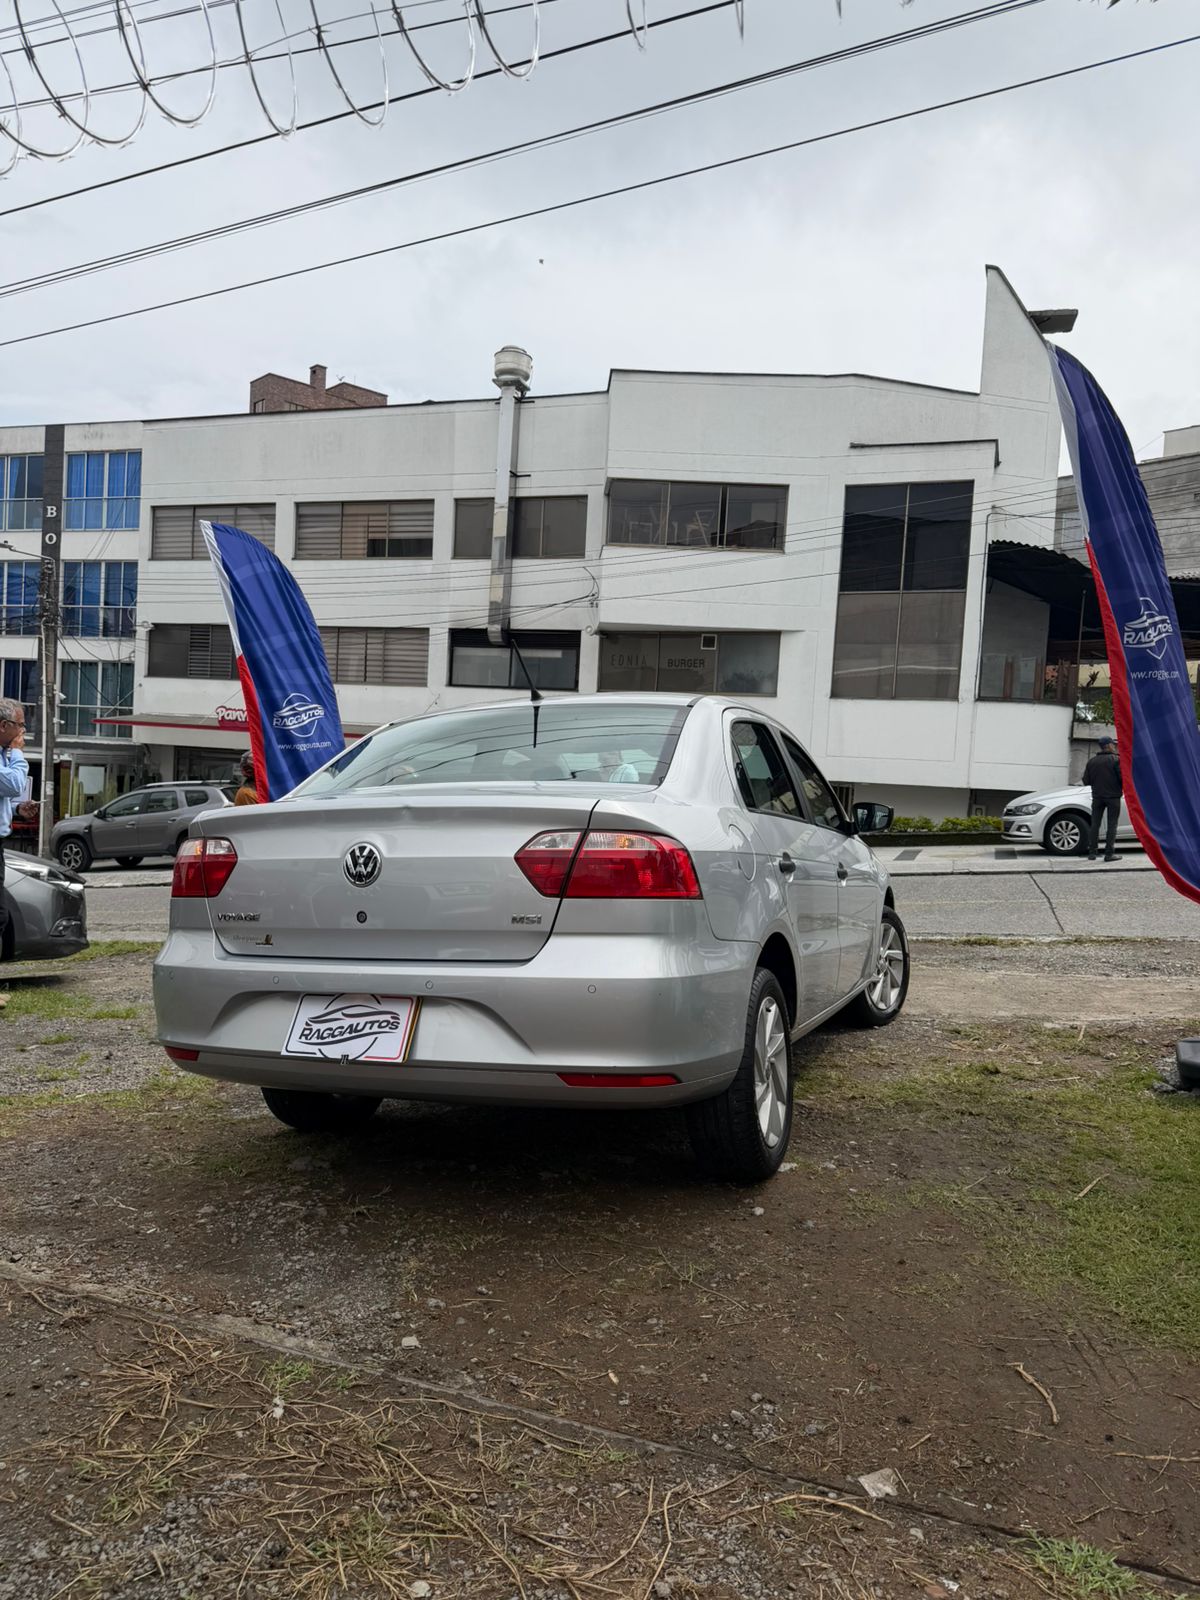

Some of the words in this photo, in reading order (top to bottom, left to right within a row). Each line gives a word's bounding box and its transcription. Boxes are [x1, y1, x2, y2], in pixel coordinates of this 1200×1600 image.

[667, 658, 705, 668] BURGER
[217, 912, 261, 921] VOYAGE
[299, 1018, 401, 1042] RAGGAUTOS
